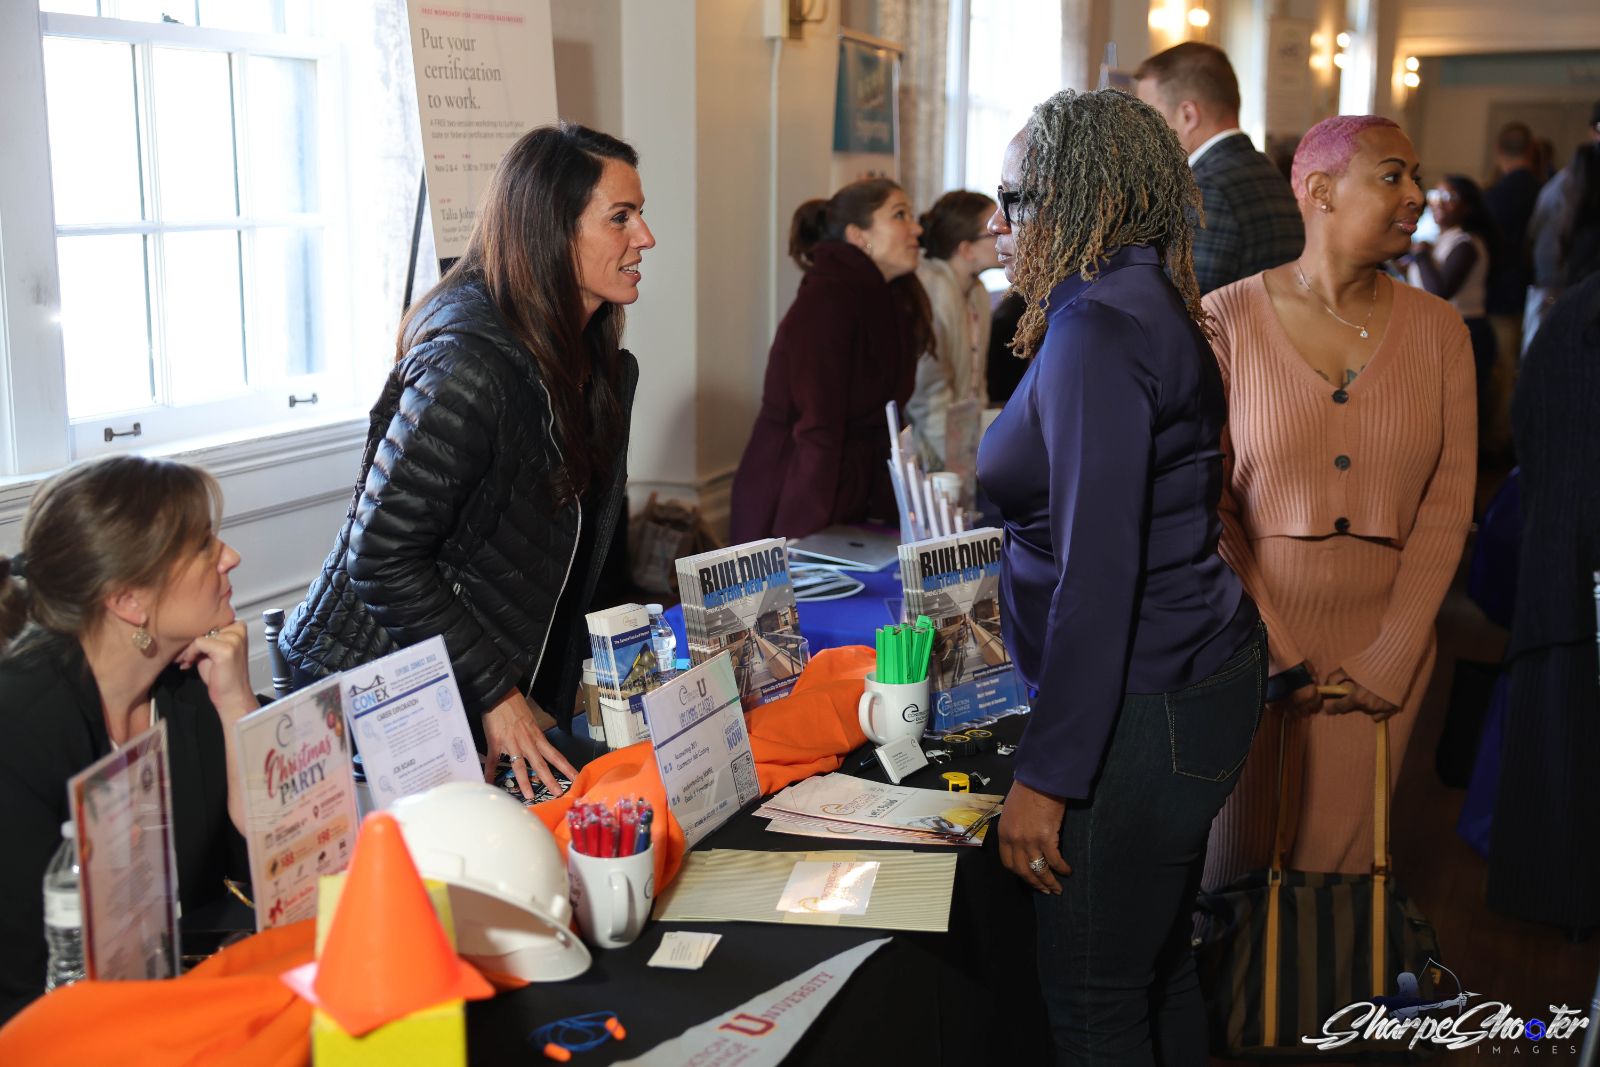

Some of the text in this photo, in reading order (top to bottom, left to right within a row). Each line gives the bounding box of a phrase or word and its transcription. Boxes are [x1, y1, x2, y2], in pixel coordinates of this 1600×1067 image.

[421, 27, 476, 54] Put your
[424, 54, 501, 81] certification
[428, 87, 481, 109] to work.
[699, 546, 786, 595] BUILDING
[919, 537, 1001, 578] BUILDING
[352, 685, 390, 712] CONEX
[726, 727, 743, 751] NOW
[264, 735, 332, 799] Christmas
[279, 759, 328, 806] PARTY
[718, 971, 834, 1037] UNIVERSITY
